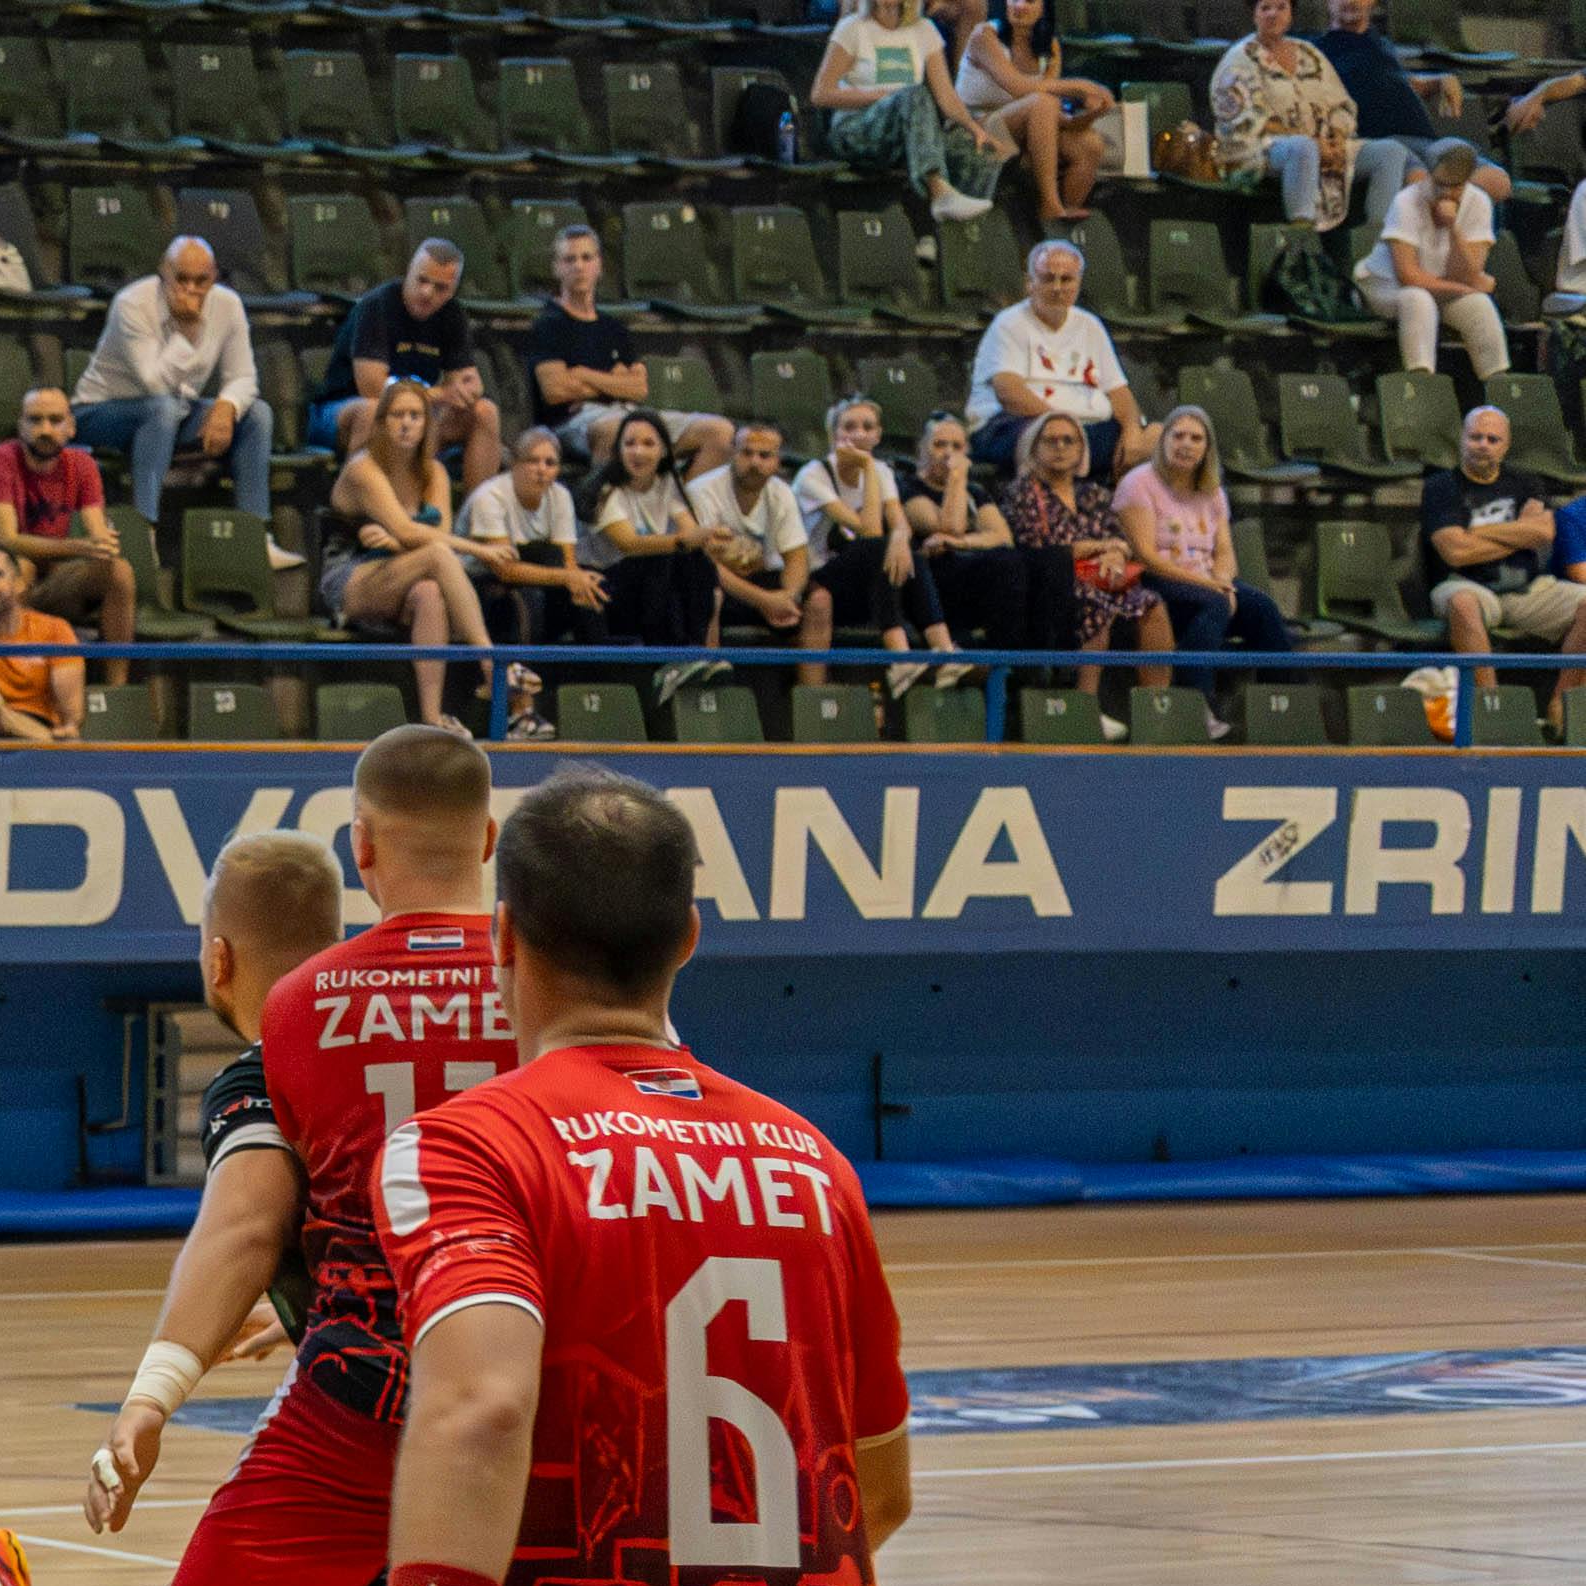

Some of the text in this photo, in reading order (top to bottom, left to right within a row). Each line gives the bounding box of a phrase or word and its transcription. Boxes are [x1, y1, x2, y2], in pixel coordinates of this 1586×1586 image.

[314, 966, 481, 992] RUKOMETNI
[314, 991, 517, 1050] ZAME
[552, 1110, 822, 1160] RUKOMETNI KLUB
[567, 1146, 832, 1236] ZAMET
[665, 1255, 801, 1568] 6
